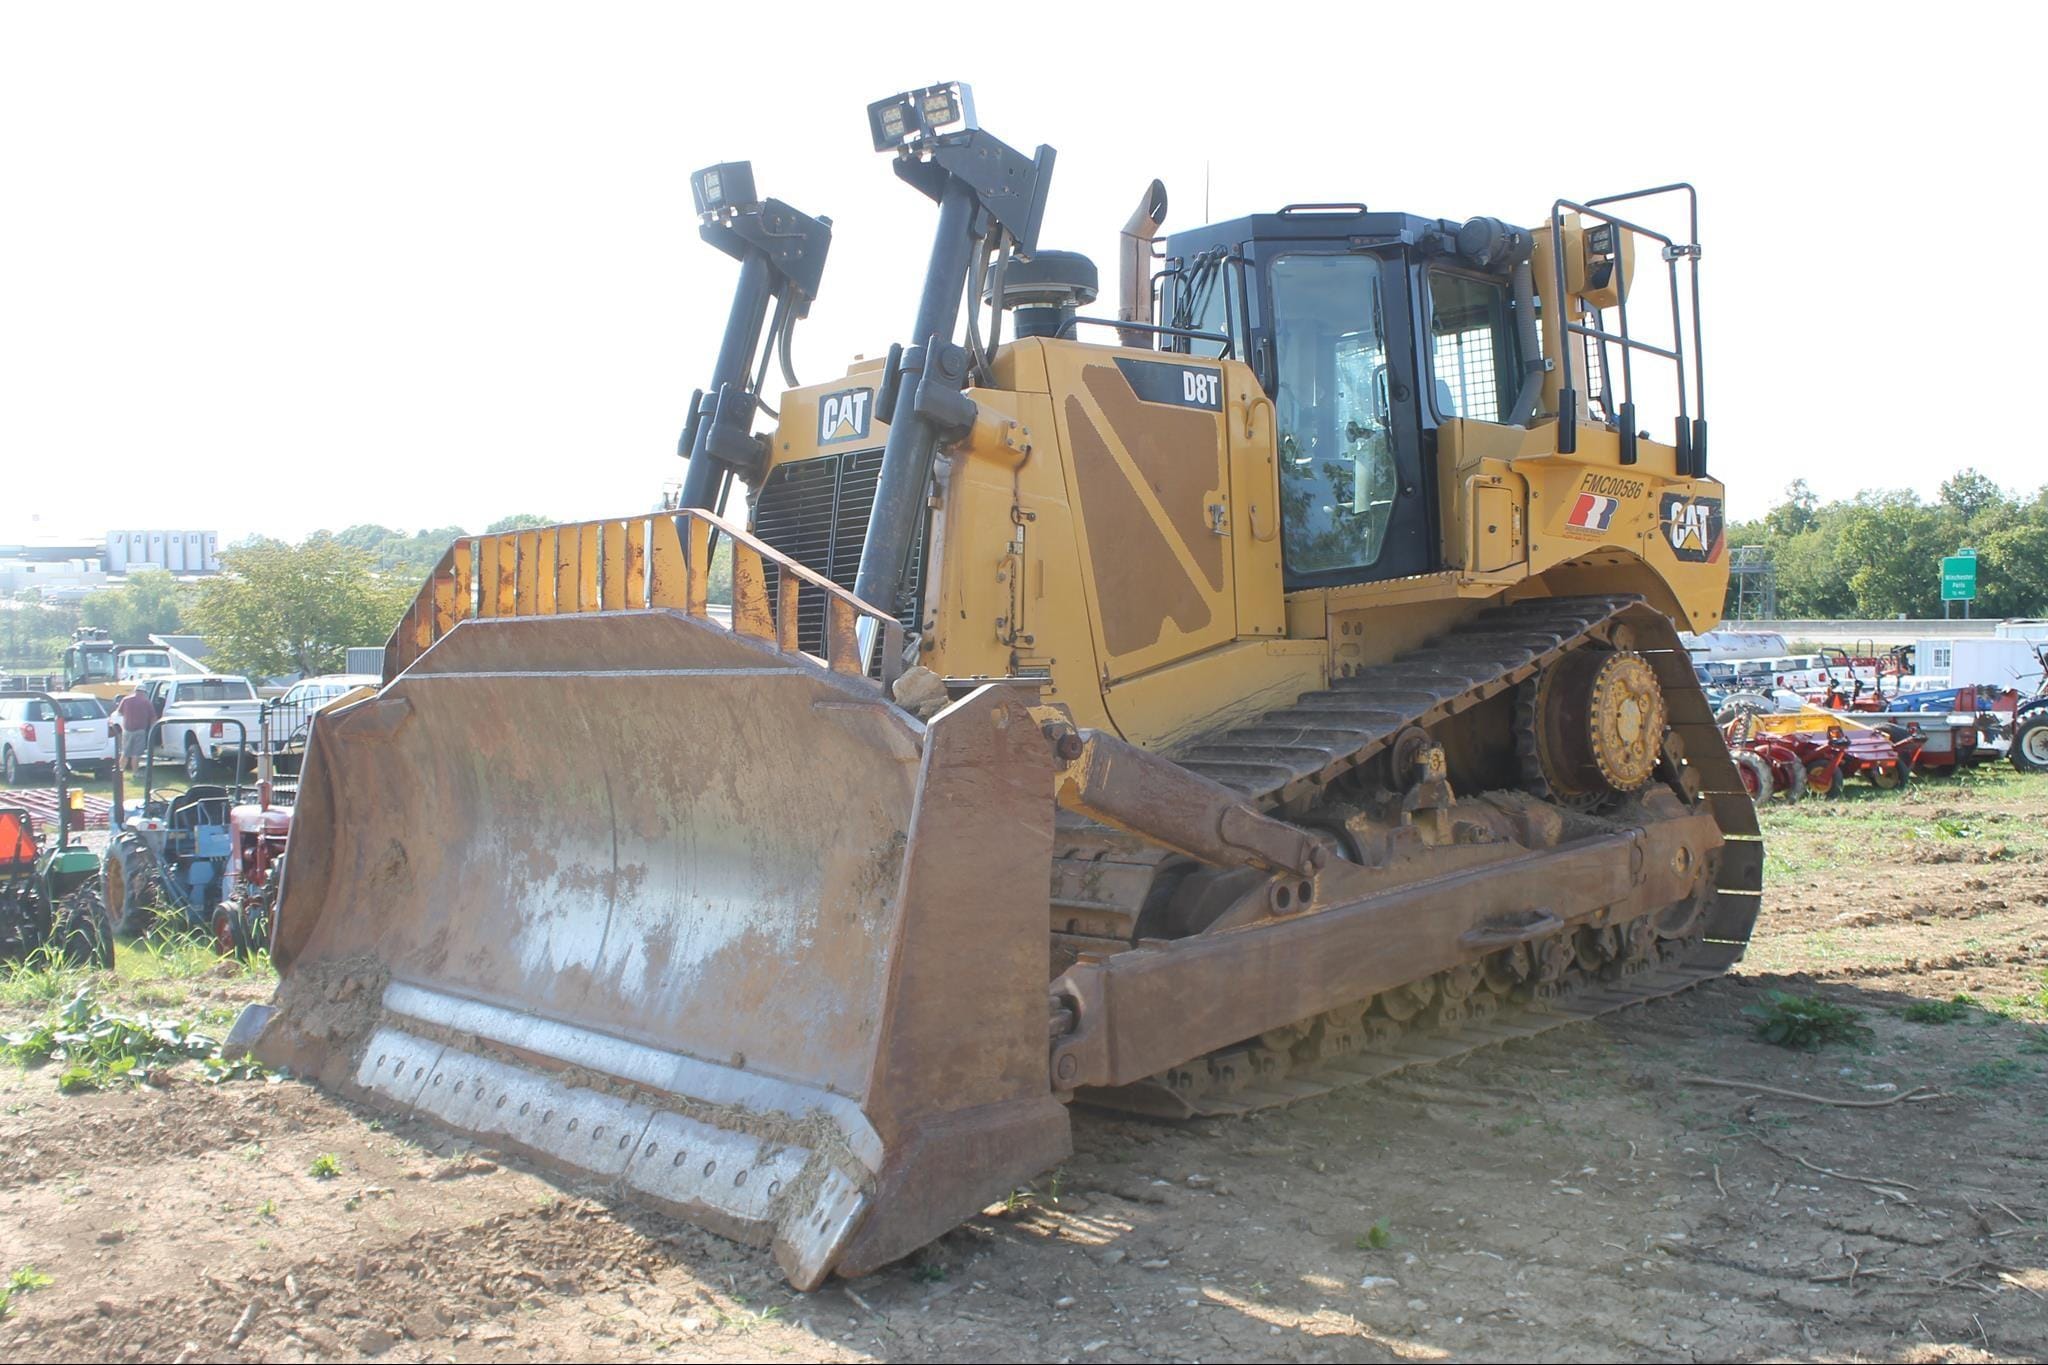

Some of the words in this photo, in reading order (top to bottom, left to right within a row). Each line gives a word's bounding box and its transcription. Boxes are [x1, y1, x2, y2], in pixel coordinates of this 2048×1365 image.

[1183, 370, 1217, 405] D8T
[822, 391, 868, 440] CAT
[1579, 472, 1645, 500] FMC00586
[1671, 501, 1710, 551] CAT
